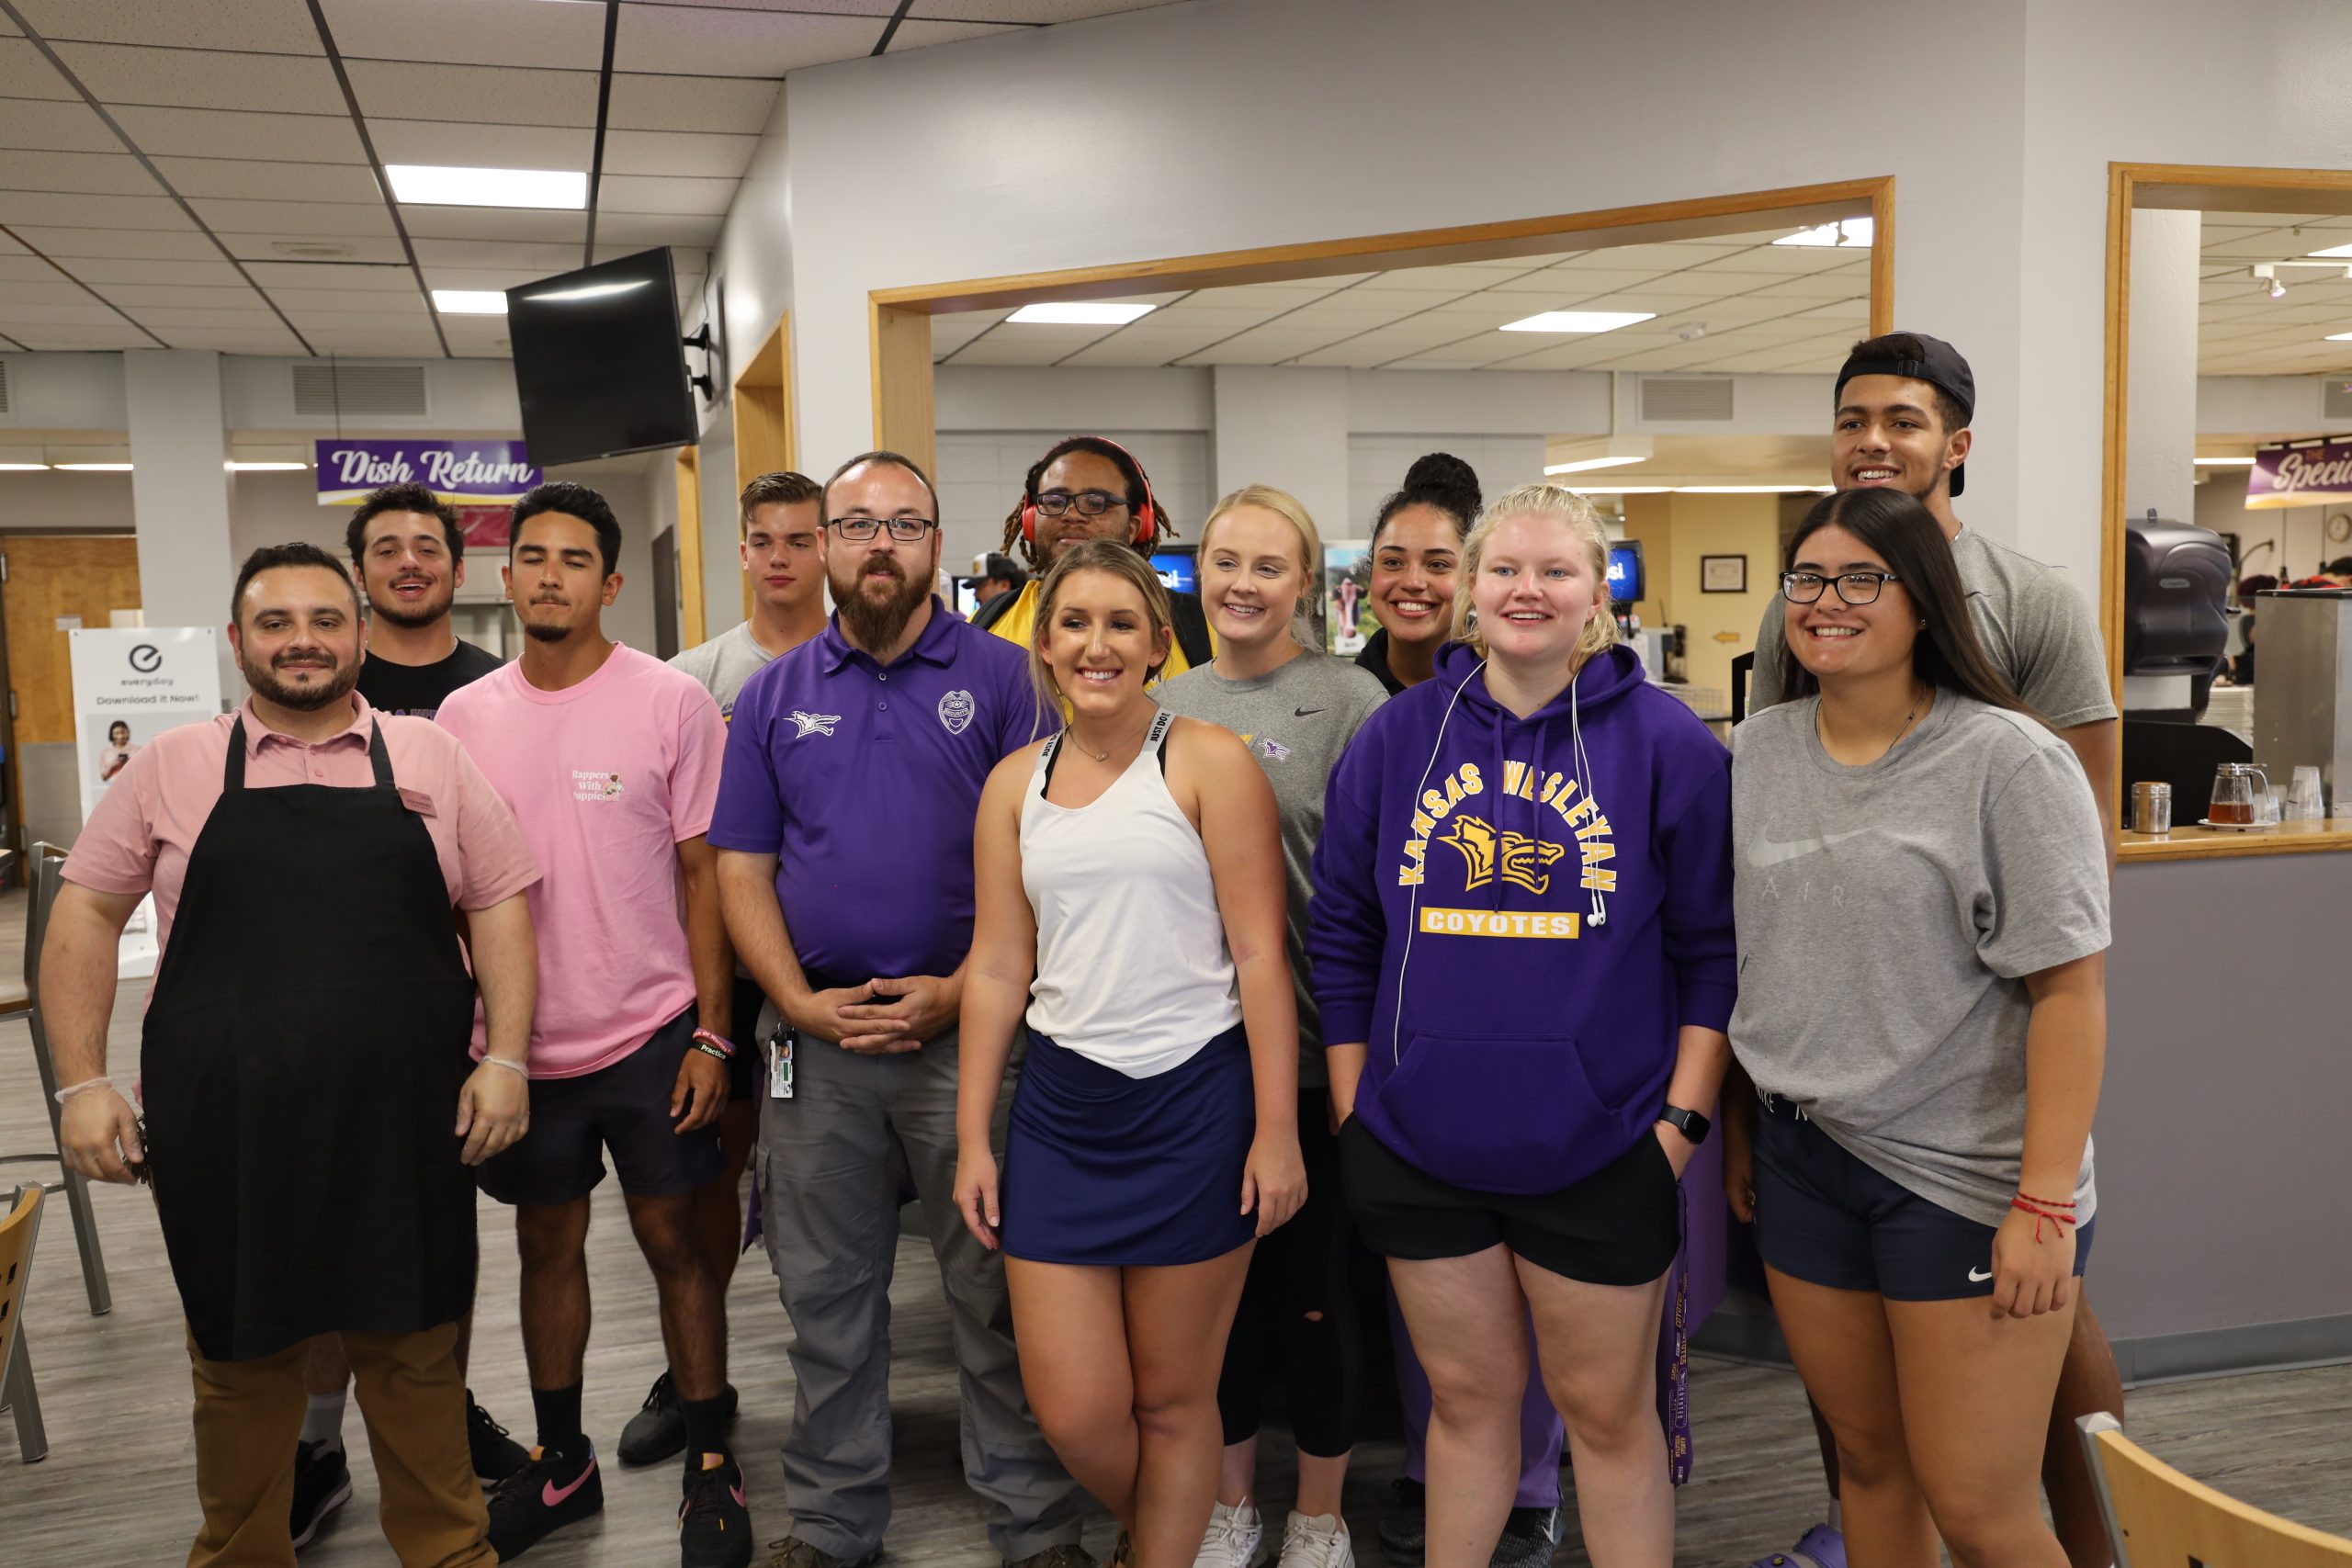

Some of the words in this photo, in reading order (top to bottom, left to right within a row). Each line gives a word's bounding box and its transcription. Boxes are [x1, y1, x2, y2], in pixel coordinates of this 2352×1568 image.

[331, 450, 414, 483] Dish
[420, 450, 535, 490] Return
[120, 677, 175, 687] everyday
[96, 695, 157, 705] Download
[159, 694, 168, 703] it
[169, 694, 199, 703] Now!
[1149, 726, 1163, 742] JUST
[1157, 716, 1168, 727] DO
[1042, 741, 1055, 757] JUST
[572, 770, 609, 781] Rappers
[579, 781, 602, 791] With
[1397, 762, 1484, 886] KANSAS
[1502, 760, 1617, 893] WESLEYAN
[1761, 875, 1846, 910] AIR
[1426, 910, 1571, 935] COYOTES
[700, 1043, 727, 1060] Practice
